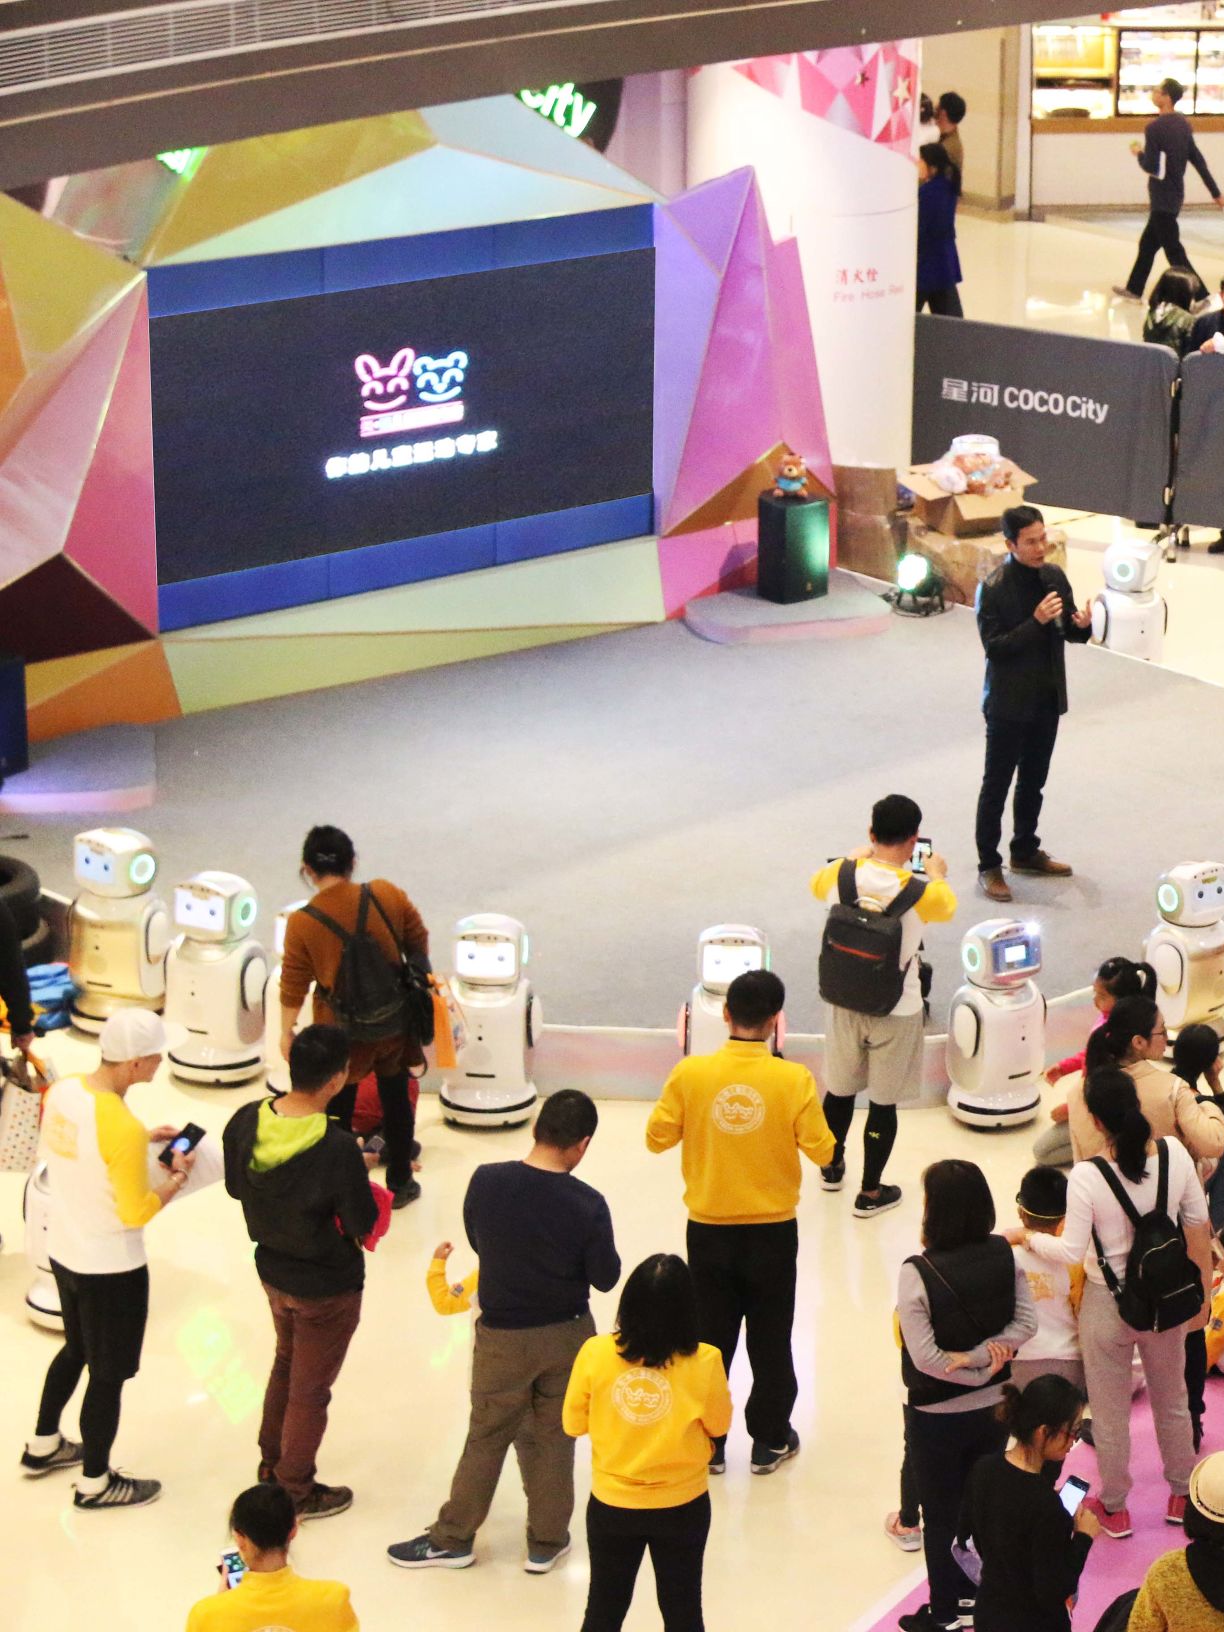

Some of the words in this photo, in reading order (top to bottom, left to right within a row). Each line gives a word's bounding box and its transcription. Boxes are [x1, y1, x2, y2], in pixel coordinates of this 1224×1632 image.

[941, 377, 1000, 406] 星河
[1003, 386, 1065, 415] COCO
[1066, 395, 1109, 424] City
